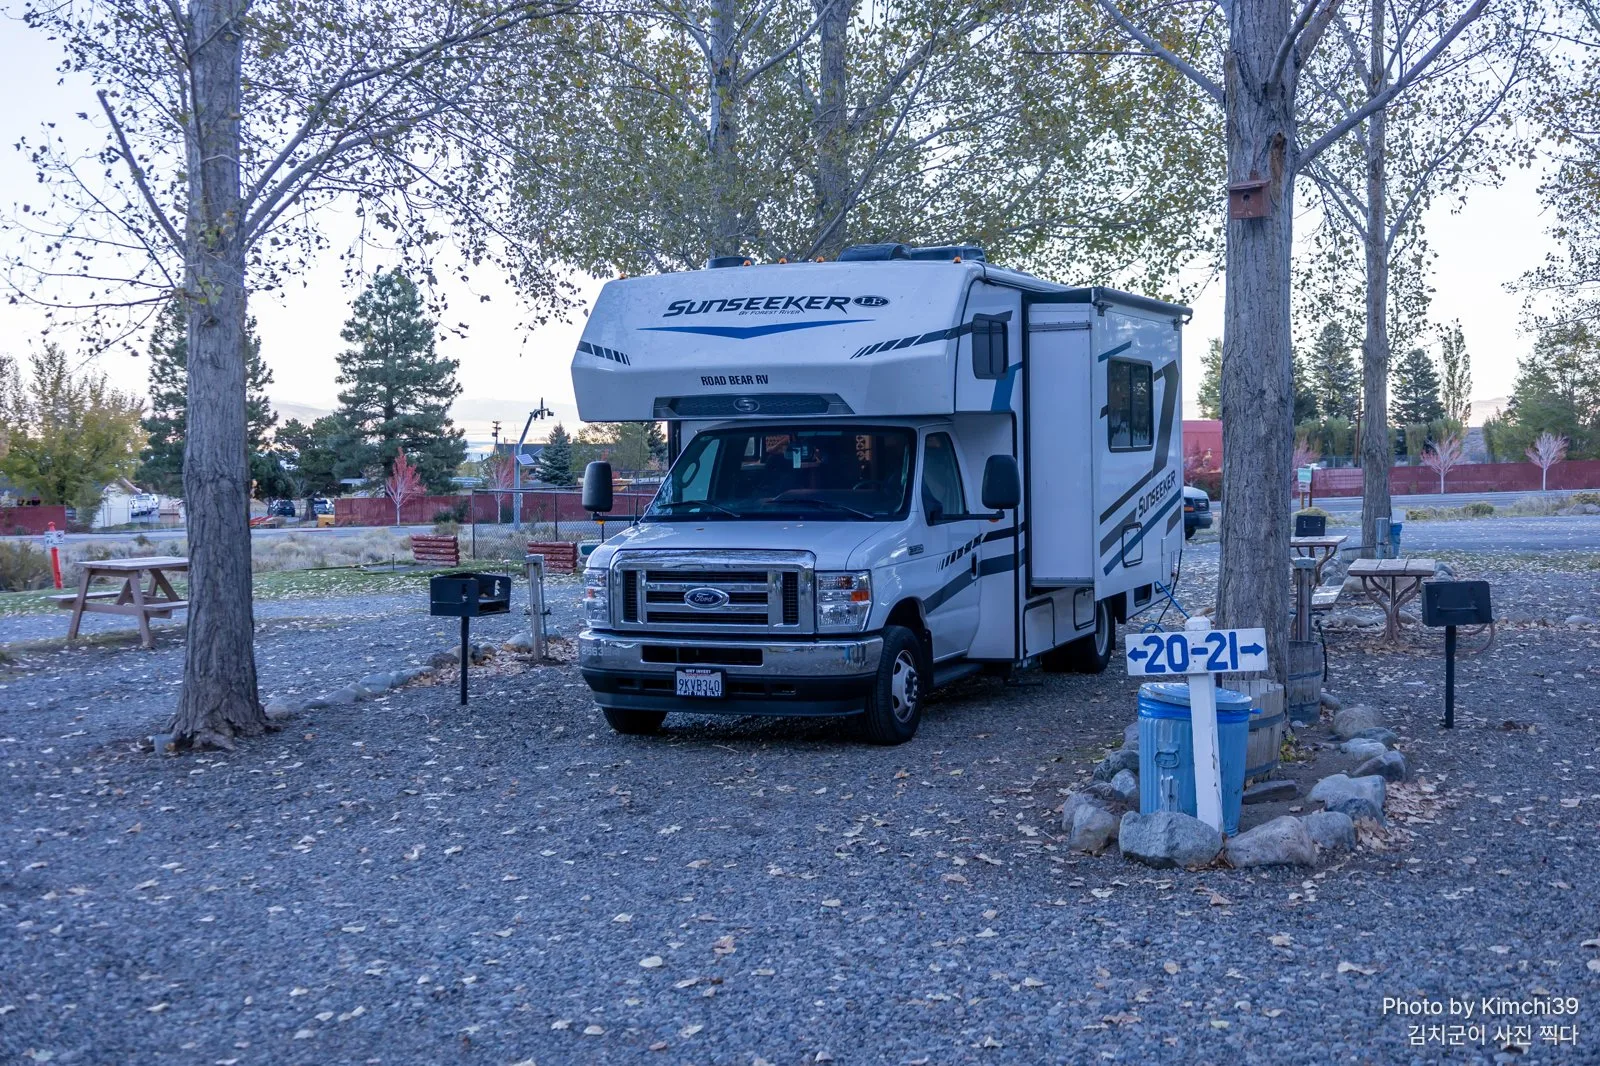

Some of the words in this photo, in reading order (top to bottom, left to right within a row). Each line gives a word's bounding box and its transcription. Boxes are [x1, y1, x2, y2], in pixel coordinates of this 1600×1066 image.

[662, 296, 851, 317] SUNSEEKER
[700, 376, 727, 386] ROAD
[728, 375, 754, 385] BEAR
[755, 374, 769, 385] RV
[694, 592, 713, 602] Ford
[1142, 631, 1239, 674] 20-21
[678, 678, 720, 692] 9KVB340
